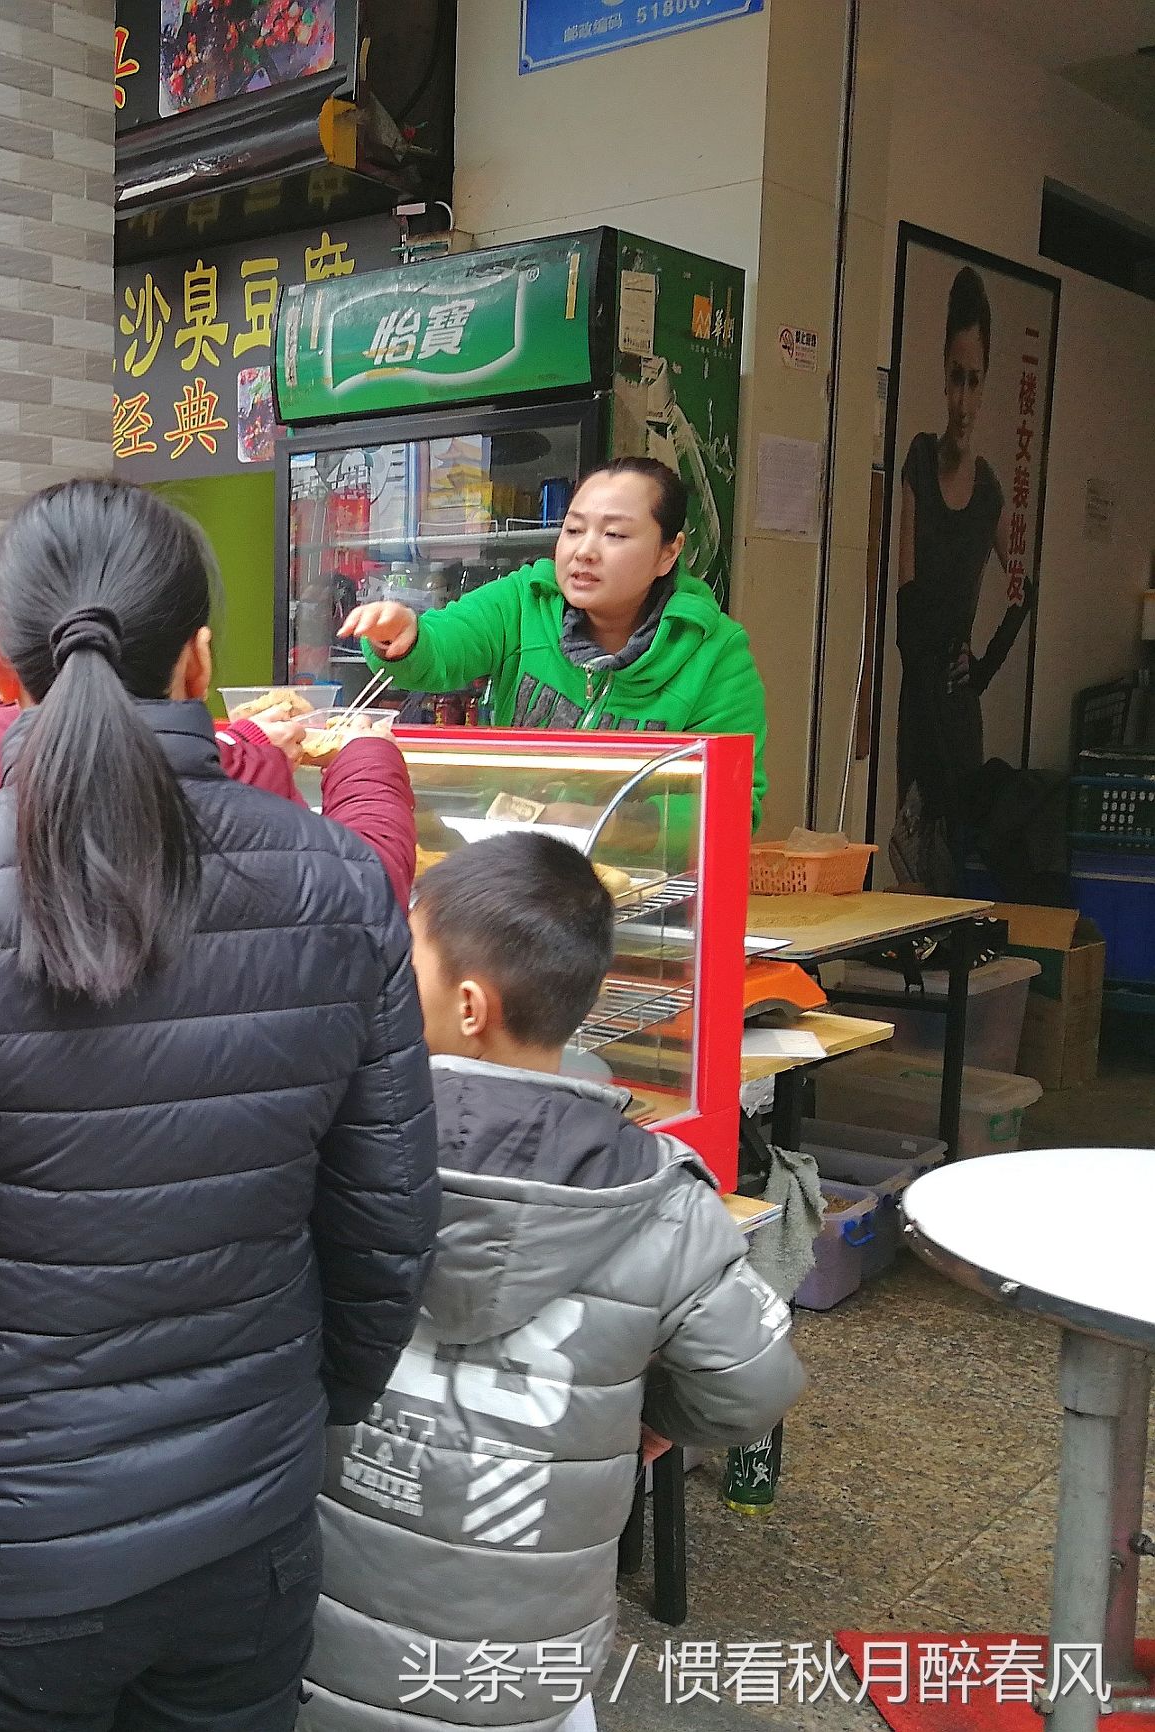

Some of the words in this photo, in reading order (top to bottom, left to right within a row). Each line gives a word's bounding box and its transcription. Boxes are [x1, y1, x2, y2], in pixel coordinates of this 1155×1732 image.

[1007, 327, 1040, 603] 二楼女装批发
